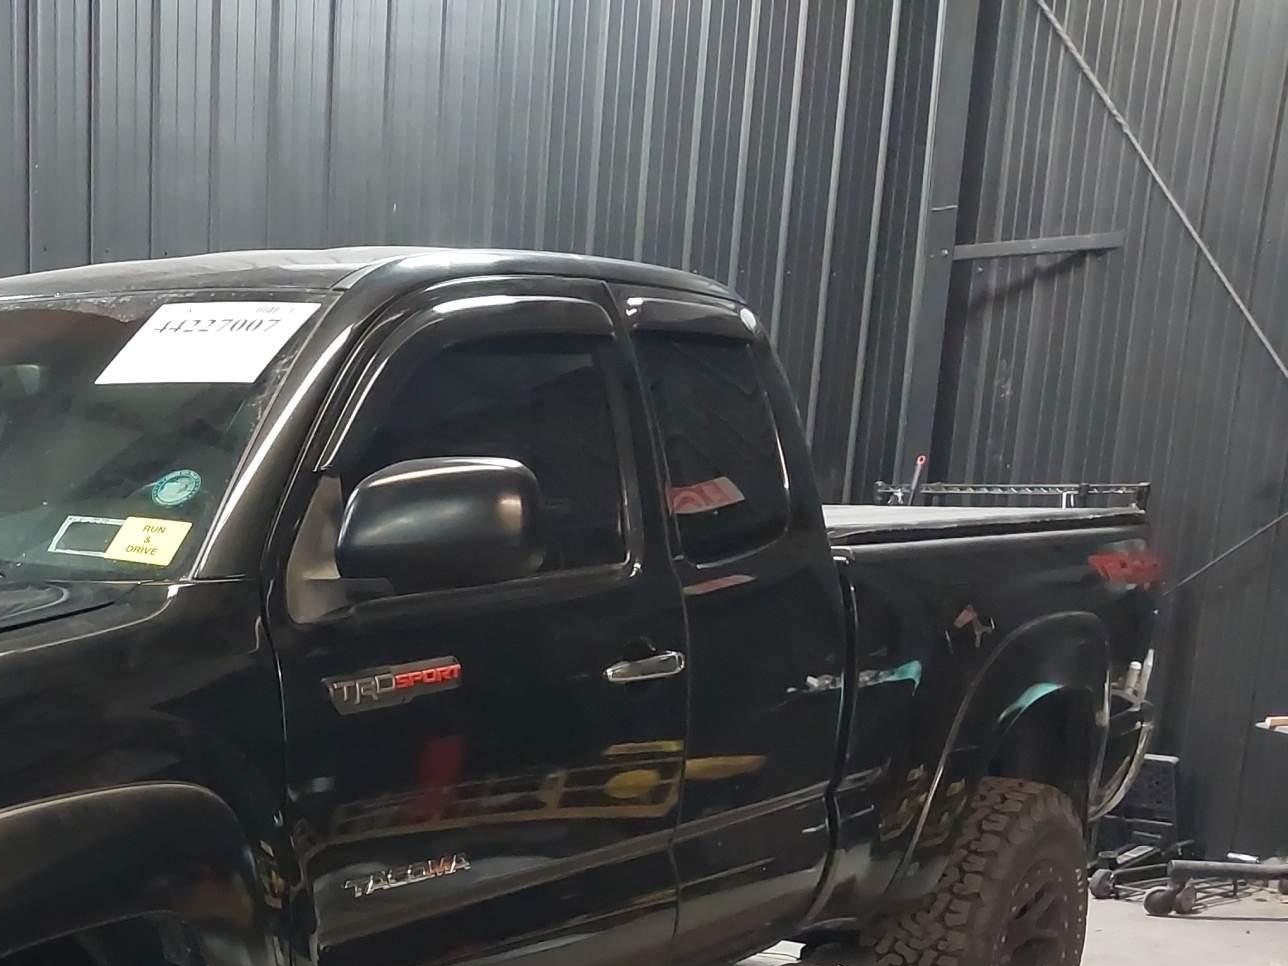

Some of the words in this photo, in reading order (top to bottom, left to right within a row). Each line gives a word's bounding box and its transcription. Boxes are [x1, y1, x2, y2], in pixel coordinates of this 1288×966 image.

[152, 318, 282, 334] 44227007
[142, 524, 166, 533] RUN
[125, 545, 159, 556] DRIVE
[395, 663, 462, 689] SPORT
[344, 853, 472, 898] TACOMA
